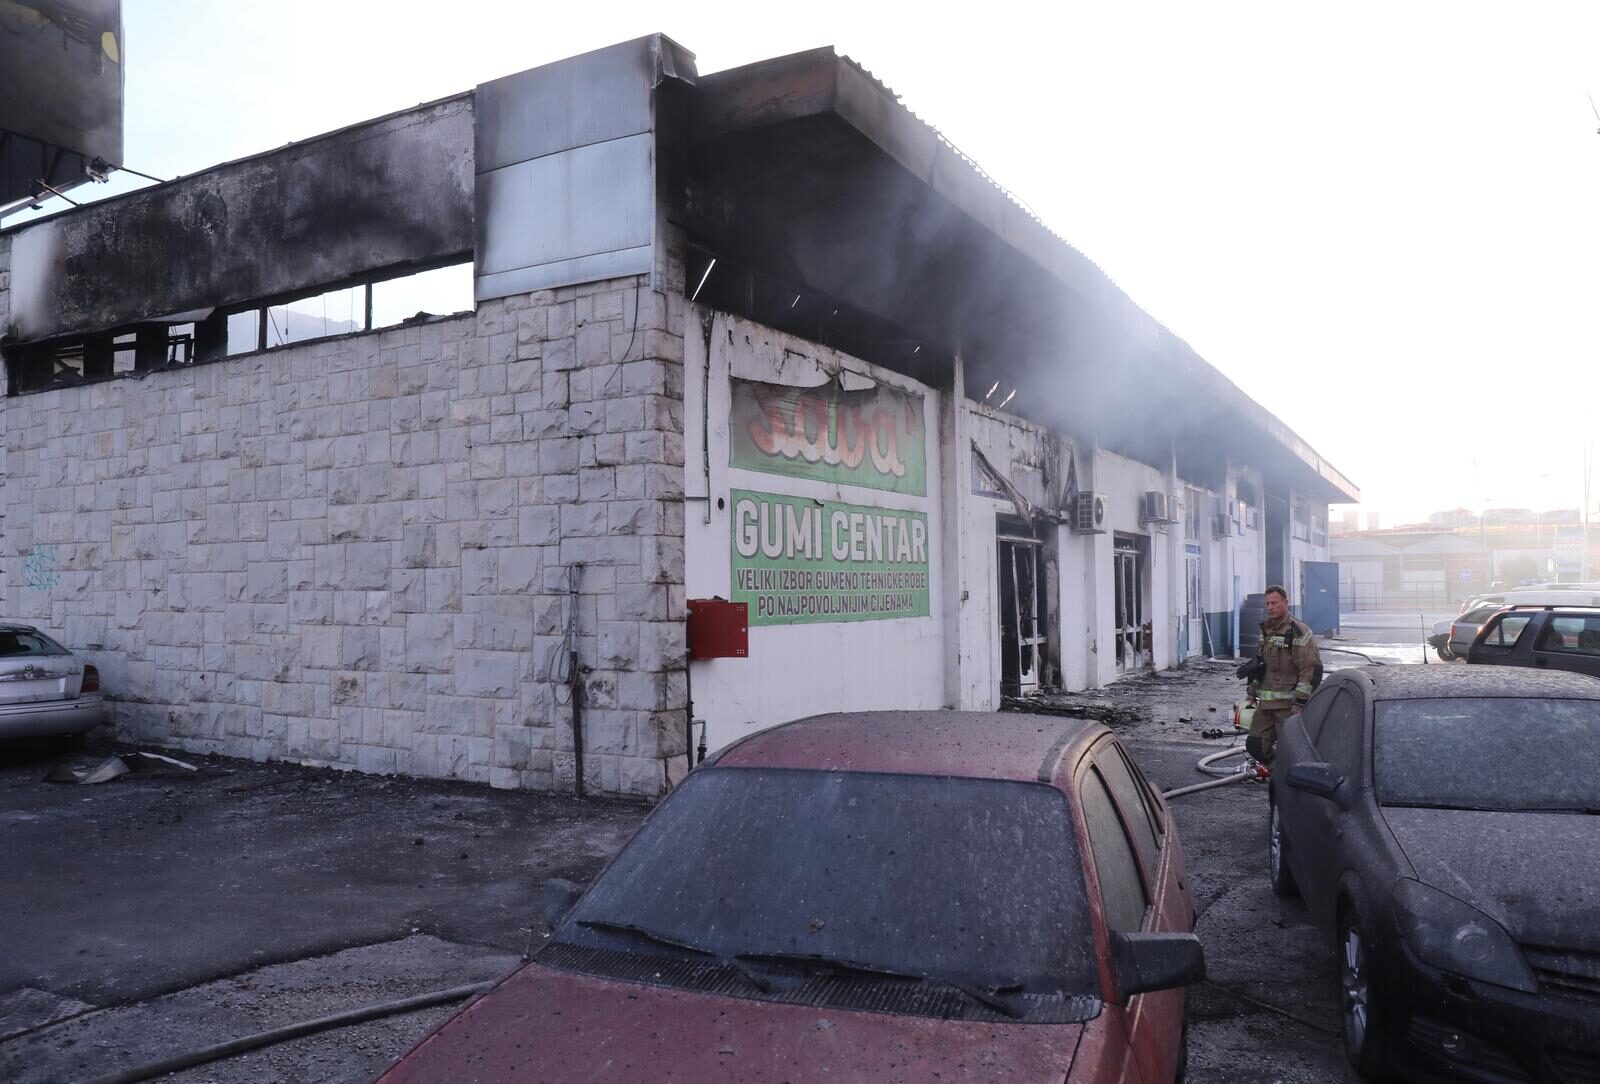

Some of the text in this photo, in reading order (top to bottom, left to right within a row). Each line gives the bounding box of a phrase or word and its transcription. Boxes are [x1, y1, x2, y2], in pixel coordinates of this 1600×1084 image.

[735, 499, 927, 563] GUMI CENTAR
[736, 569, 776, 590] VELIKI
[778, 569, 813, 590] IZBOR
[815, 570, 858, 590] GUMENO
[904, 572, 926, 589] ROBE
[758, 593, 913, 617] PO NAJPOVOLJNIJIM CIJENAMA
